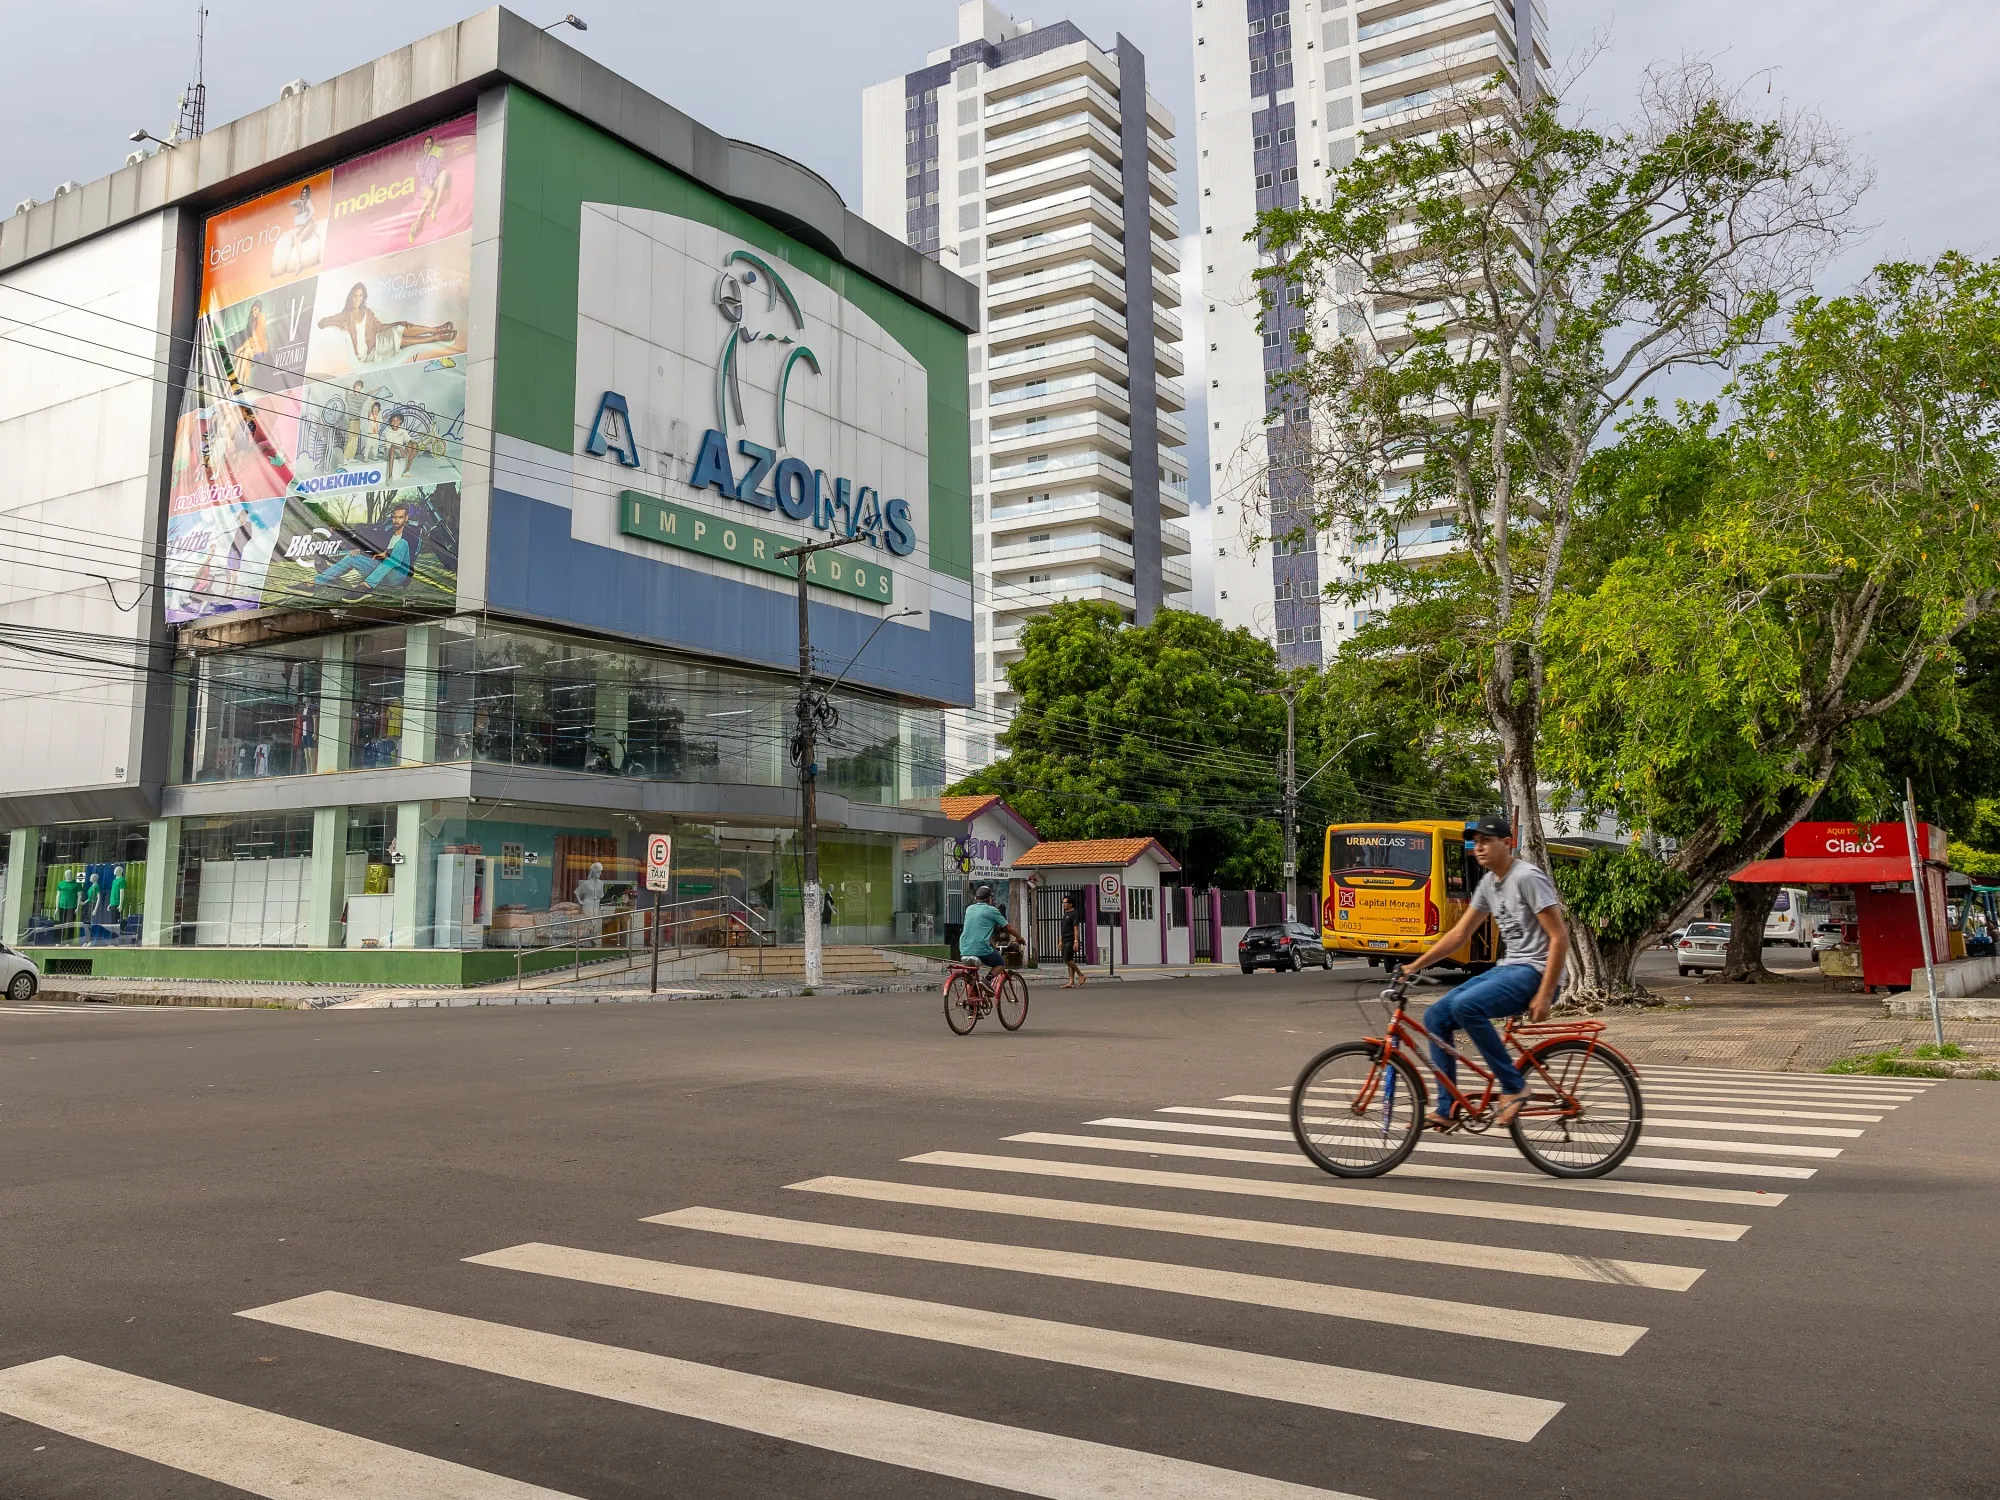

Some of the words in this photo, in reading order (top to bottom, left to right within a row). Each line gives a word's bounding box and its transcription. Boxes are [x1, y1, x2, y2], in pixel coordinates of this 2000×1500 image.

[334, 176, 415, 219] moleca
[210, 234, 254, 265] beira
[258, 223, 281, 247] rio
[378, 266, 441, 293] MODARE
[274, 347, 305, 368] VIZZANO
[296, 470, 382, 494] MOLEKINHO
[633, 502, 889, 594] IMPORTADOS
[1827, 828, 1845, 836] AQUI
[655, 844, 664, 860] E
[1409, 838, 1425, 850] 311
[1825, 838, 1876, 853] Claro
[1107, 880, 1113, 891] E
[1359, 898, 1387, 909] Capital
[1389, 899, 1421, 908] Morena
[1338, 921, 1362, 930] 06033
